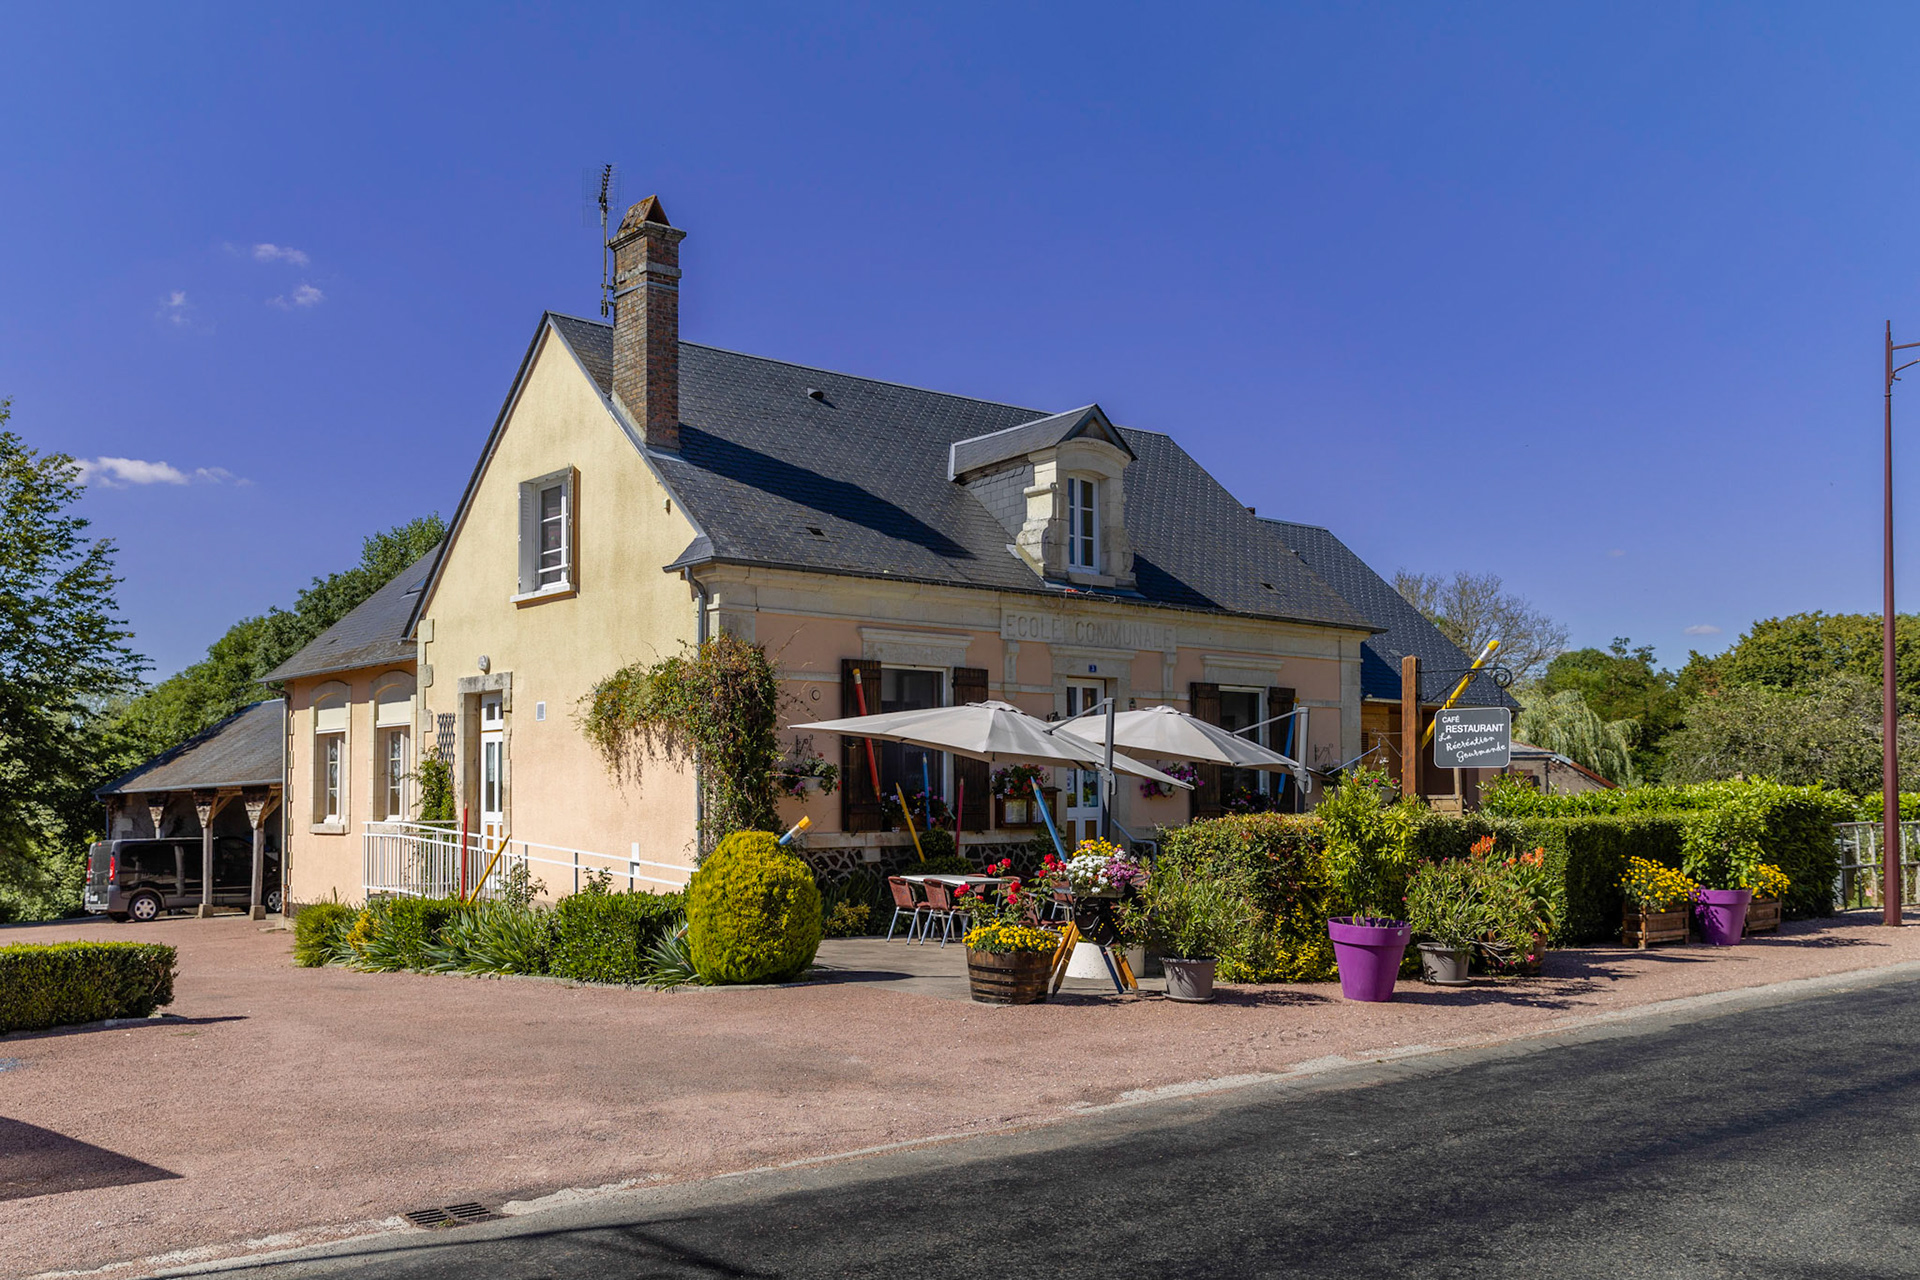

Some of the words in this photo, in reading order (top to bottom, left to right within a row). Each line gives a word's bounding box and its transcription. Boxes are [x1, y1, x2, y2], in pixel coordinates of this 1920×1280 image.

[1006, 614, 1061, 640] ECOLE
[1075, 621, 1173, 649] COMMUNALE
[1442, 715, 1460, 723] CAFÉ
[1445, 724, 1504, 733] RESTAURANT
[1439, 732, 1452, 741] La
[1446, 736, 1495, 751] Récréation
[1456, 742, 1506, 762] Gourmande
